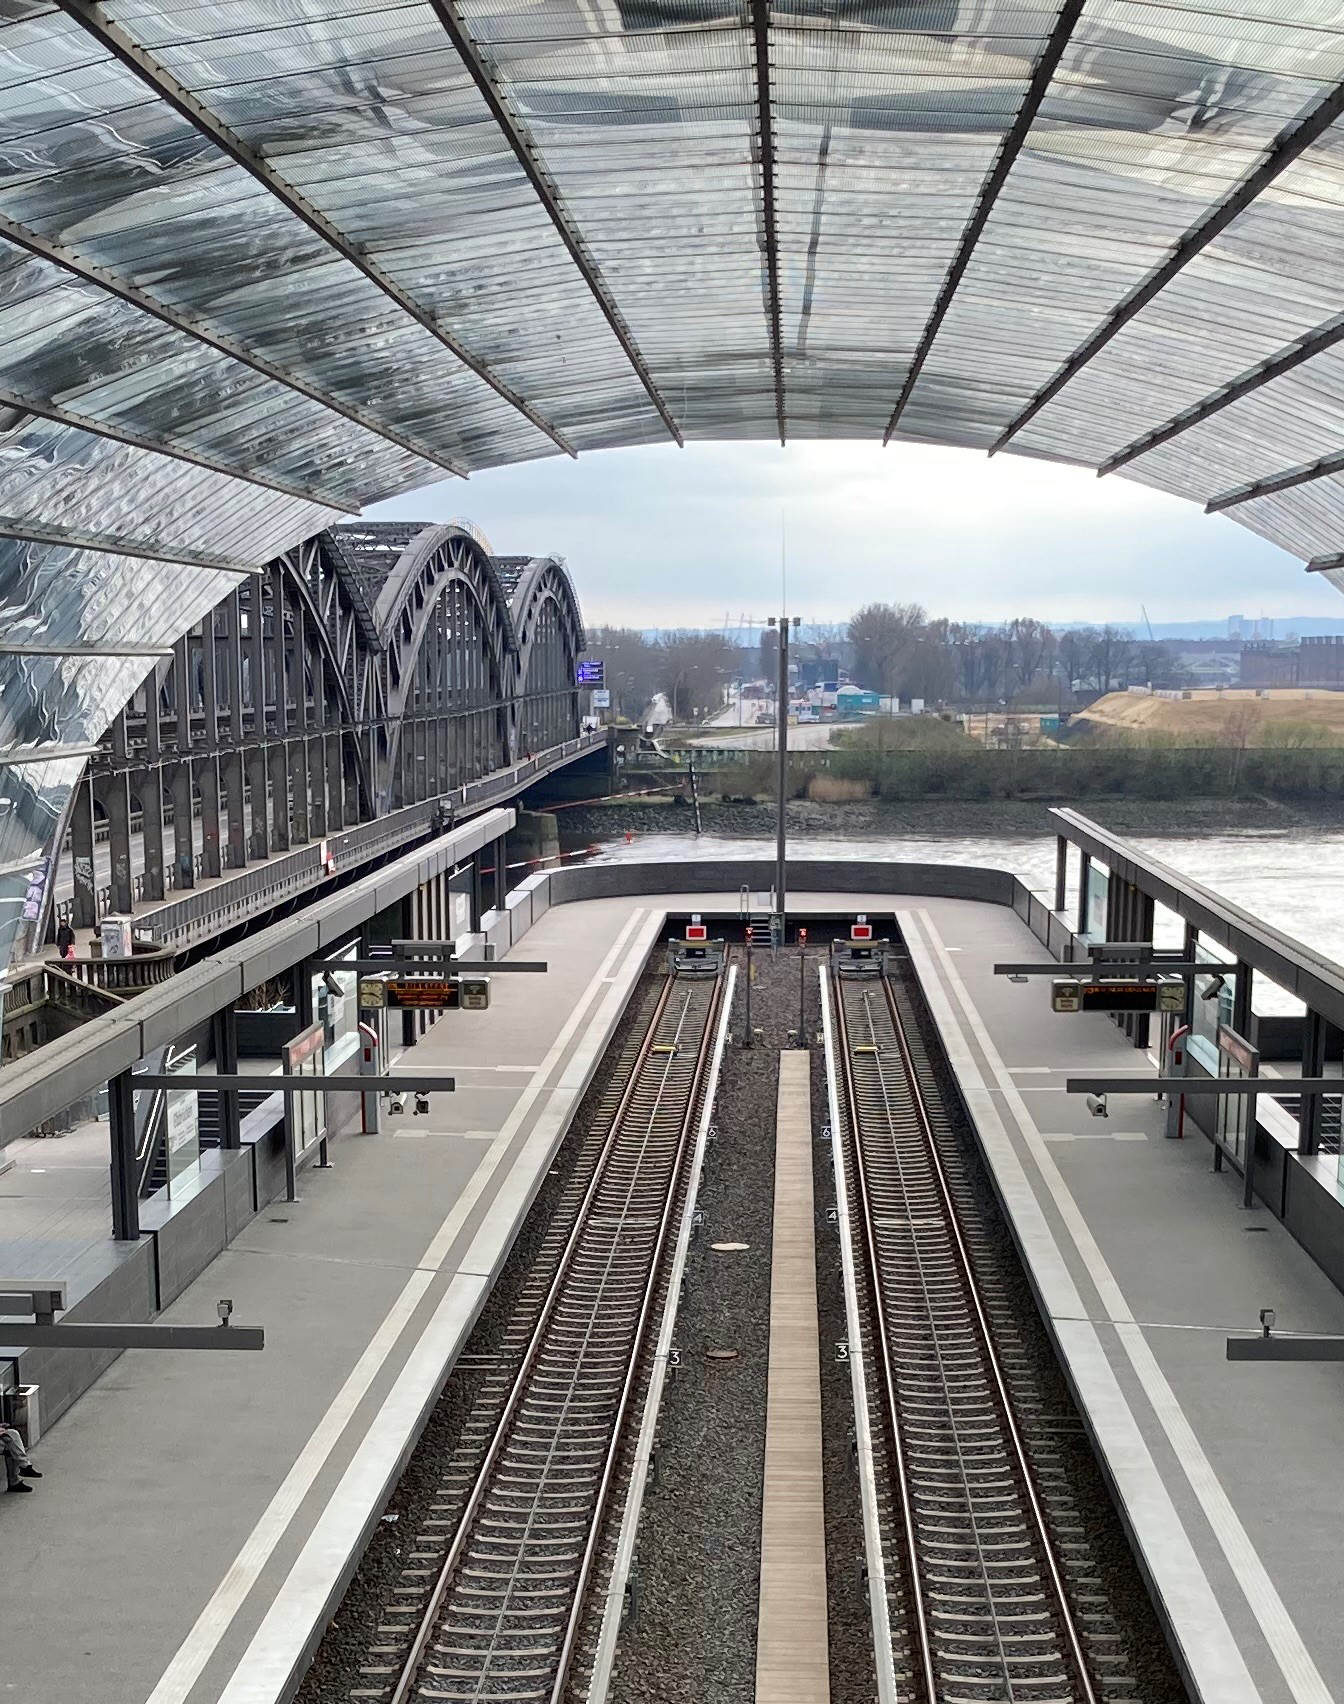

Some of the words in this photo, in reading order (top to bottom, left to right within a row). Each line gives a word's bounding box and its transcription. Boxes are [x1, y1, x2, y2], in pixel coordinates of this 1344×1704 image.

[709, 1127, 716, 1137] 6
[822, 1127, 831, 1138] 6
[693, 1213, 703, 1223] 4
[828, 1211, 837, 1220] 4
[837, 1345, 848, 1359] 3
[669, 1351, 680, 1365] 3
